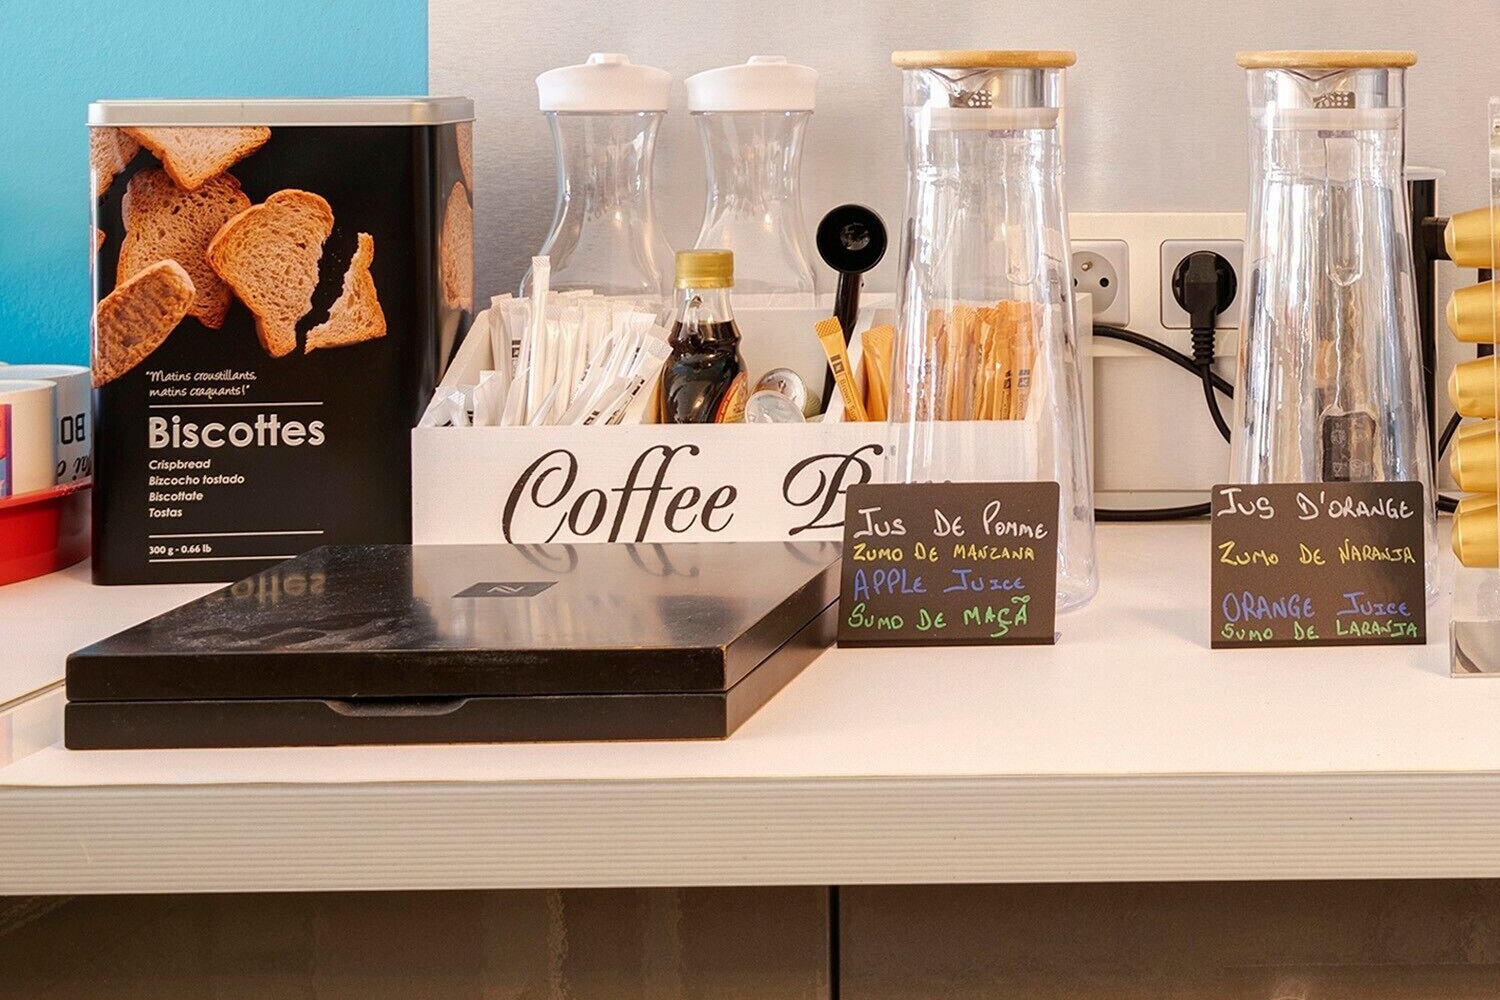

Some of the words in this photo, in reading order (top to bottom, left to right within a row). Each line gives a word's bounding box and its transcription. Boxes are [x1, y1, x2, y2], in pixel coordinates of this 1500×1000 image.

[149, 387, 187, 397] matins
[148, 413, 326, 449] Biscottes
[148, 459, 211, 471] Crispbread
[148, 474, 200, 486] Bizcocho
[202, 473, 246, 485] tostado
[148, 491, 203, 502] Biscottate
[501, 444, 739, 543] Coffee
[148, 507, 183, 518] Tostas
[149, 545, 166, 555] 300
[167, 547, 174, 556] g
[181, 544, 200, 554] 0.66
[202, 543, 212, 553] lb
[1299, 542, 1326, 565] DE
[1339, 538, 1416, 564] NARANJA
[854, 568, 927, 601] APPLE
[1222, 590, 1316, 622] ORANGE
[1294, 621, 1320, 641] DE
[1335, 619, 1418, 638] LARANJA
